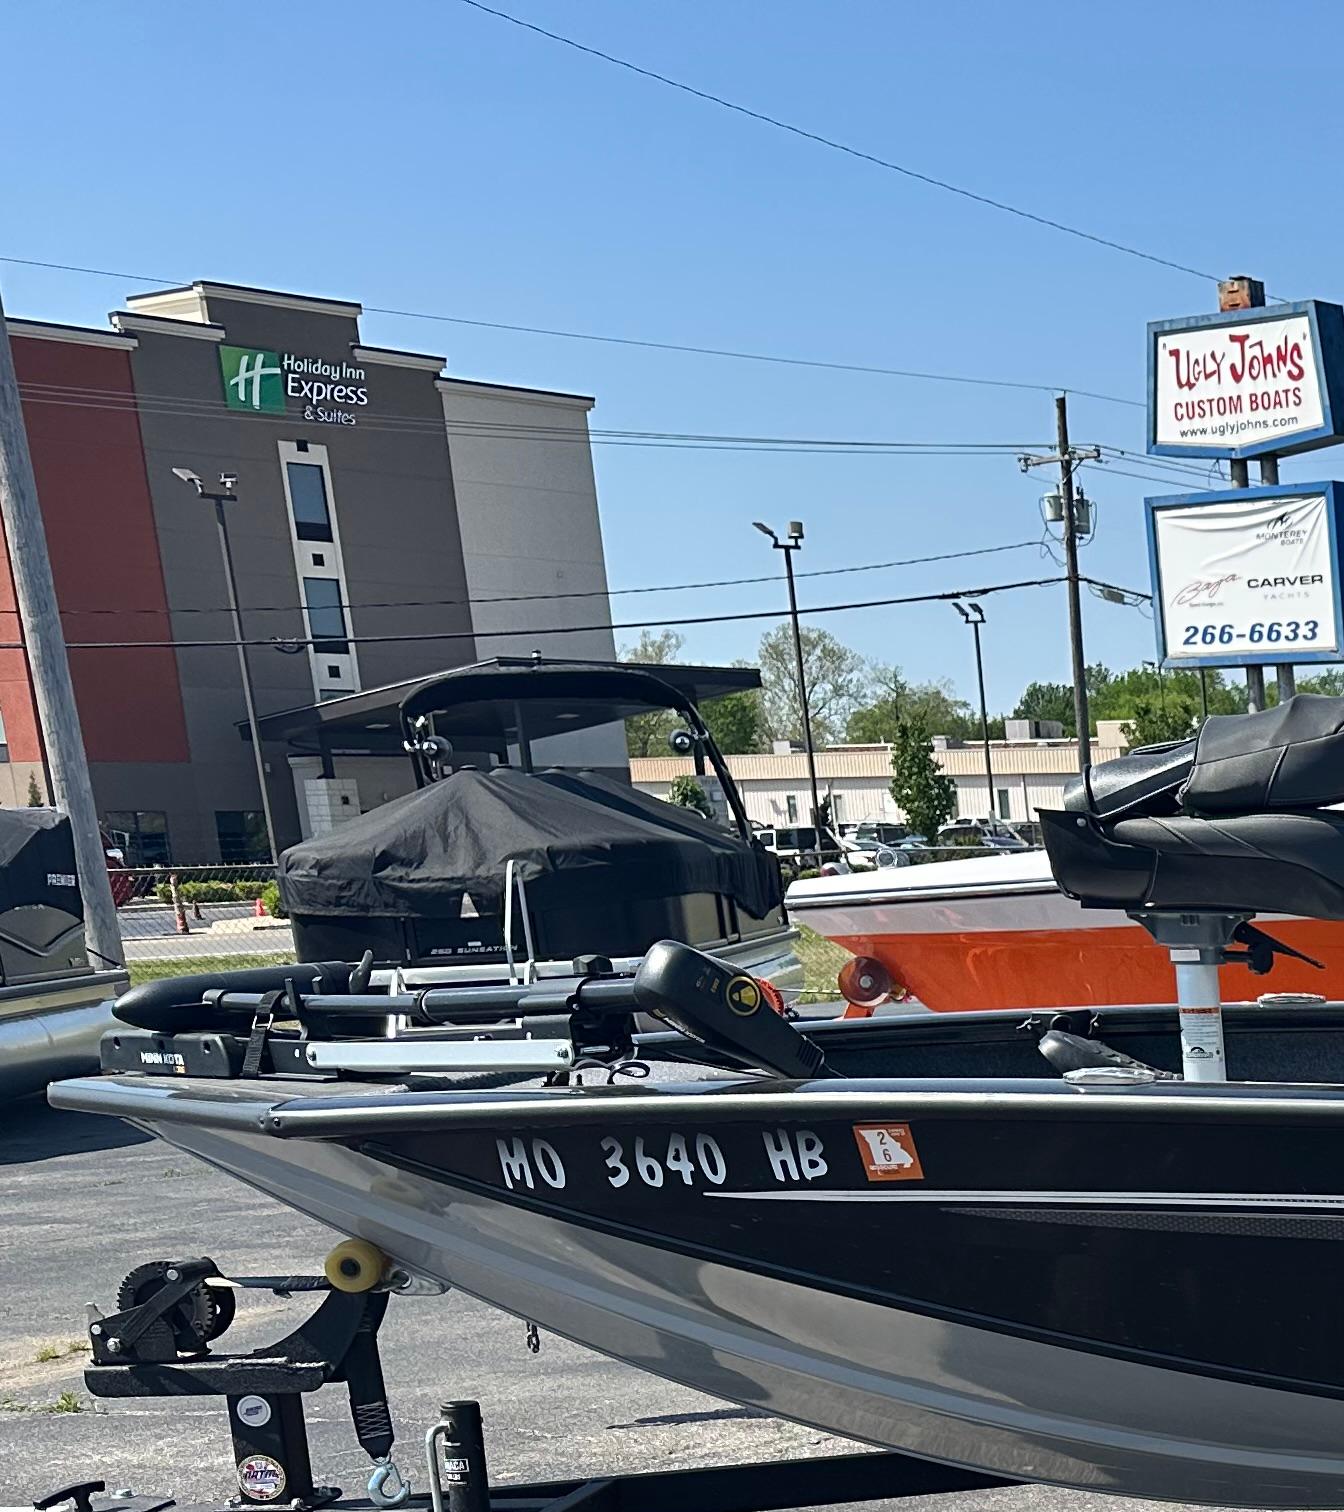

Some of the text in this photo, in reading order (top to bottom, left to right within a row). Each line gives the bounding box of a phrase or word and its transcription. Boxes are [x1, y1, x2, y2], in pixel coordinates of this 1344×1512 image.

[282, 353, 365, 381] Holiday Inn
[287, 374, 368, 405] Express
[1174, 387, 1303, 421] CUSTOM BOATS
[304, 405, 356, 425] & Suites
[1179, 416, 1299, 438] www.uglyjohns.com
[1255, 529, 1308, 542] MONTEREY
[1246, 574, 1324, 589] CARVER
[1263, 591, 1311, 601] YACHTS
[1182, 620, 1320, 646] 266-6633
[877, 1131, 887, 1146] 2
[496, 1128, 828, 1190] MO 3640 HB
[882, 1148, 892, 1162] 6
